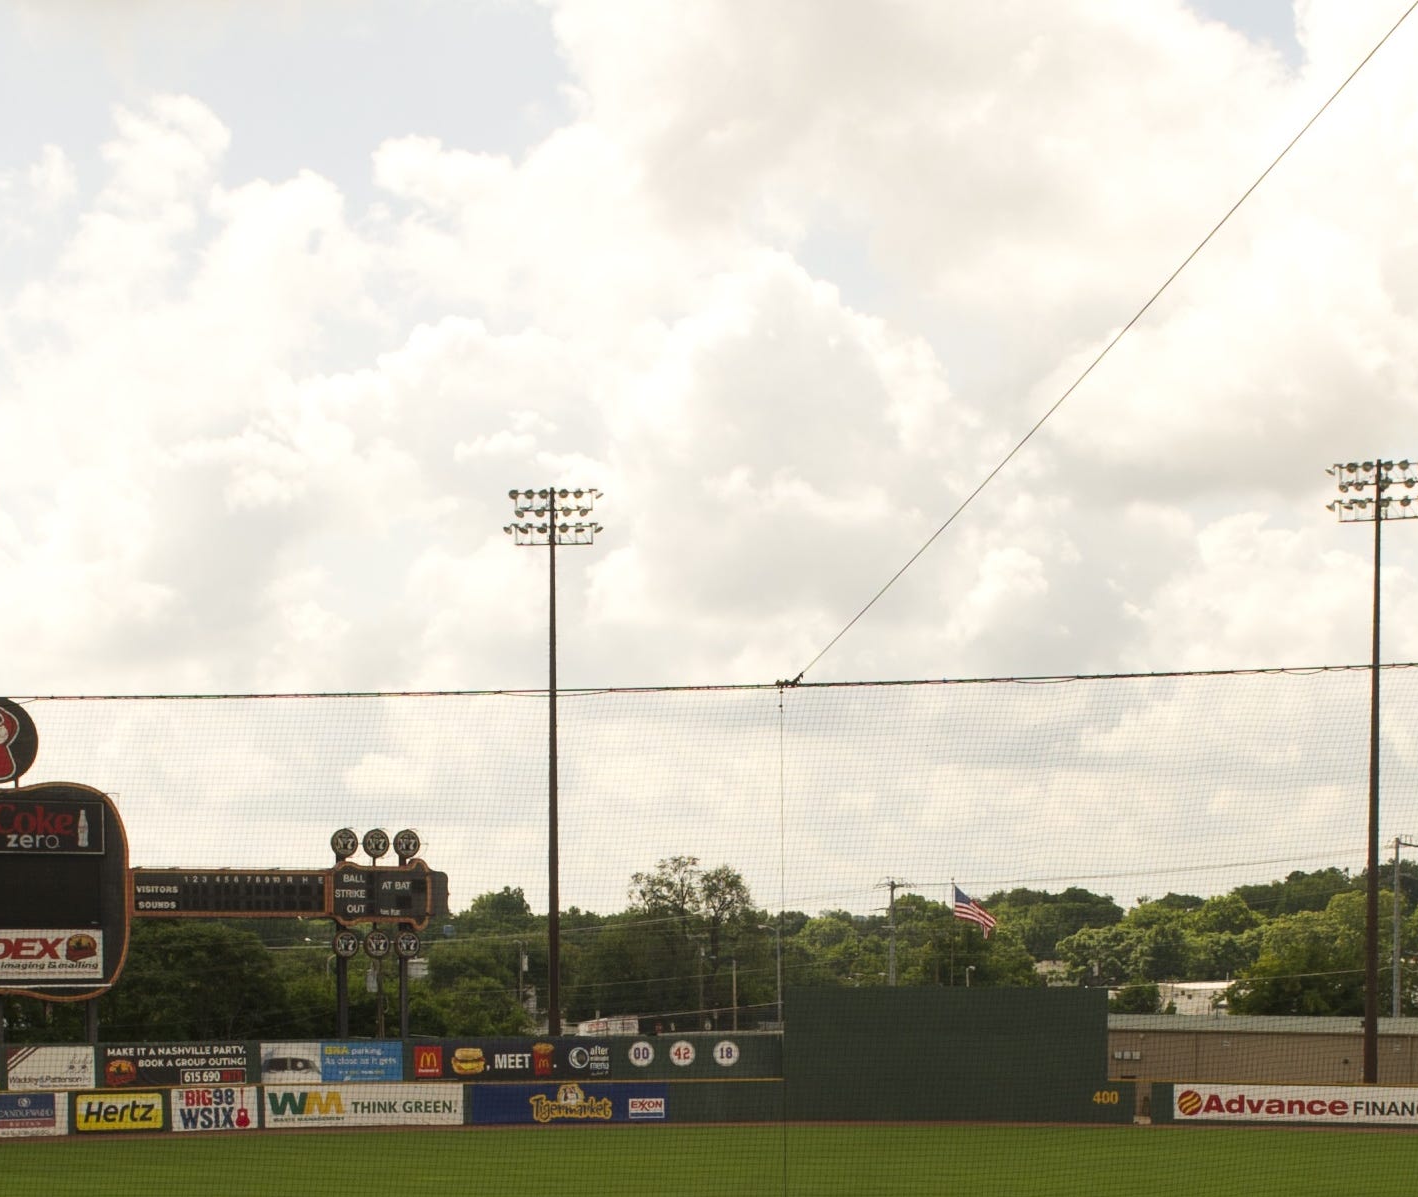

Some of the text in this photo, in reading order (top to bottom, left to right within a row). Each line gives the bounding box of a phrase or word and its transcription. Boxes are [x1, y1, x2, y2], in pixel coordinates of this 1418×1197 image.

[6, 834, 59, 848] zero
[343, 874, 365, 883] BALL
[136, 885, 179, 894] VISITORS
[381, 881, 411, 889] AT BAT
[335, 889, 366, 899] STRIKE
[138, 901, 176, 909] SOUNDS
[346, 904, 365, 914] OUT
[58, 961, 99, 970] mailing
[107, 1045, 246, 1056] MAKE IT A NASHVILLE PARTY.
[589, 1045, 609, 1055] after
[633, 1047, 650, 1059] 00
[674, 1048, 691, 1059] 42
[719, 1047, 733, 1059] 18
[138, 1057, 247, 1067] BOOK A GROUP OUTING!
[494, 1053, 531, 1069] MEET
[184, 1071, 221, 1083] 615 690
[1093, 1091, 1119, 1105] 400
[352, 1100, 457, 1114] THINK GREEN.
[531, 1095, 612, 1121] Tigermarket
[631, 1100, 663, 1111] EXXON
[1203, 1094, 1349, 1116] Advance
[84, 1100, 155, 1123] Hertz
[181, 1107, 235, 1129] WSIX
